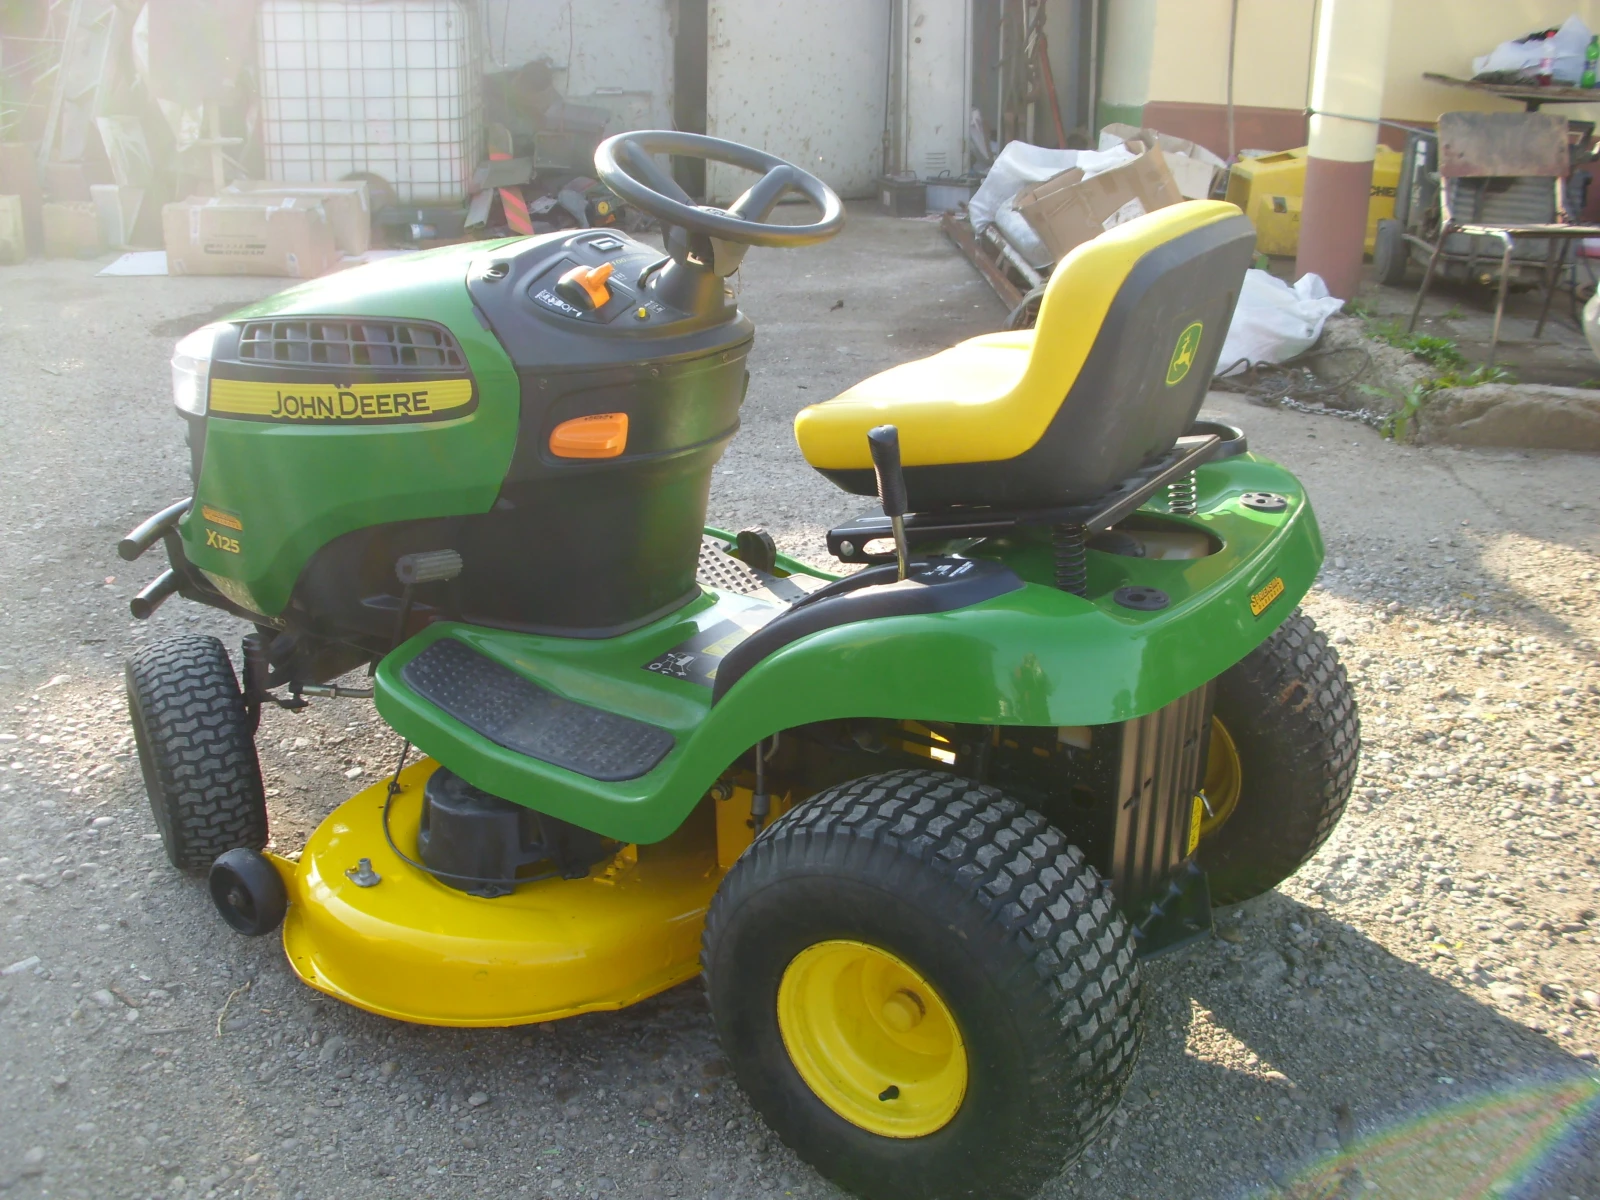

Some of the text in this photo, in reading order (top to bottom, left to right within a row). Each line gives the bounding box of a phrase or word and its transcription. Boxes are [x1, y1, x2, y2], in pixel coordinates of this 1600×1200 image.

[271, 391, 430, 416] JOHN DEERE
[206, 528, 241, 554] X125
